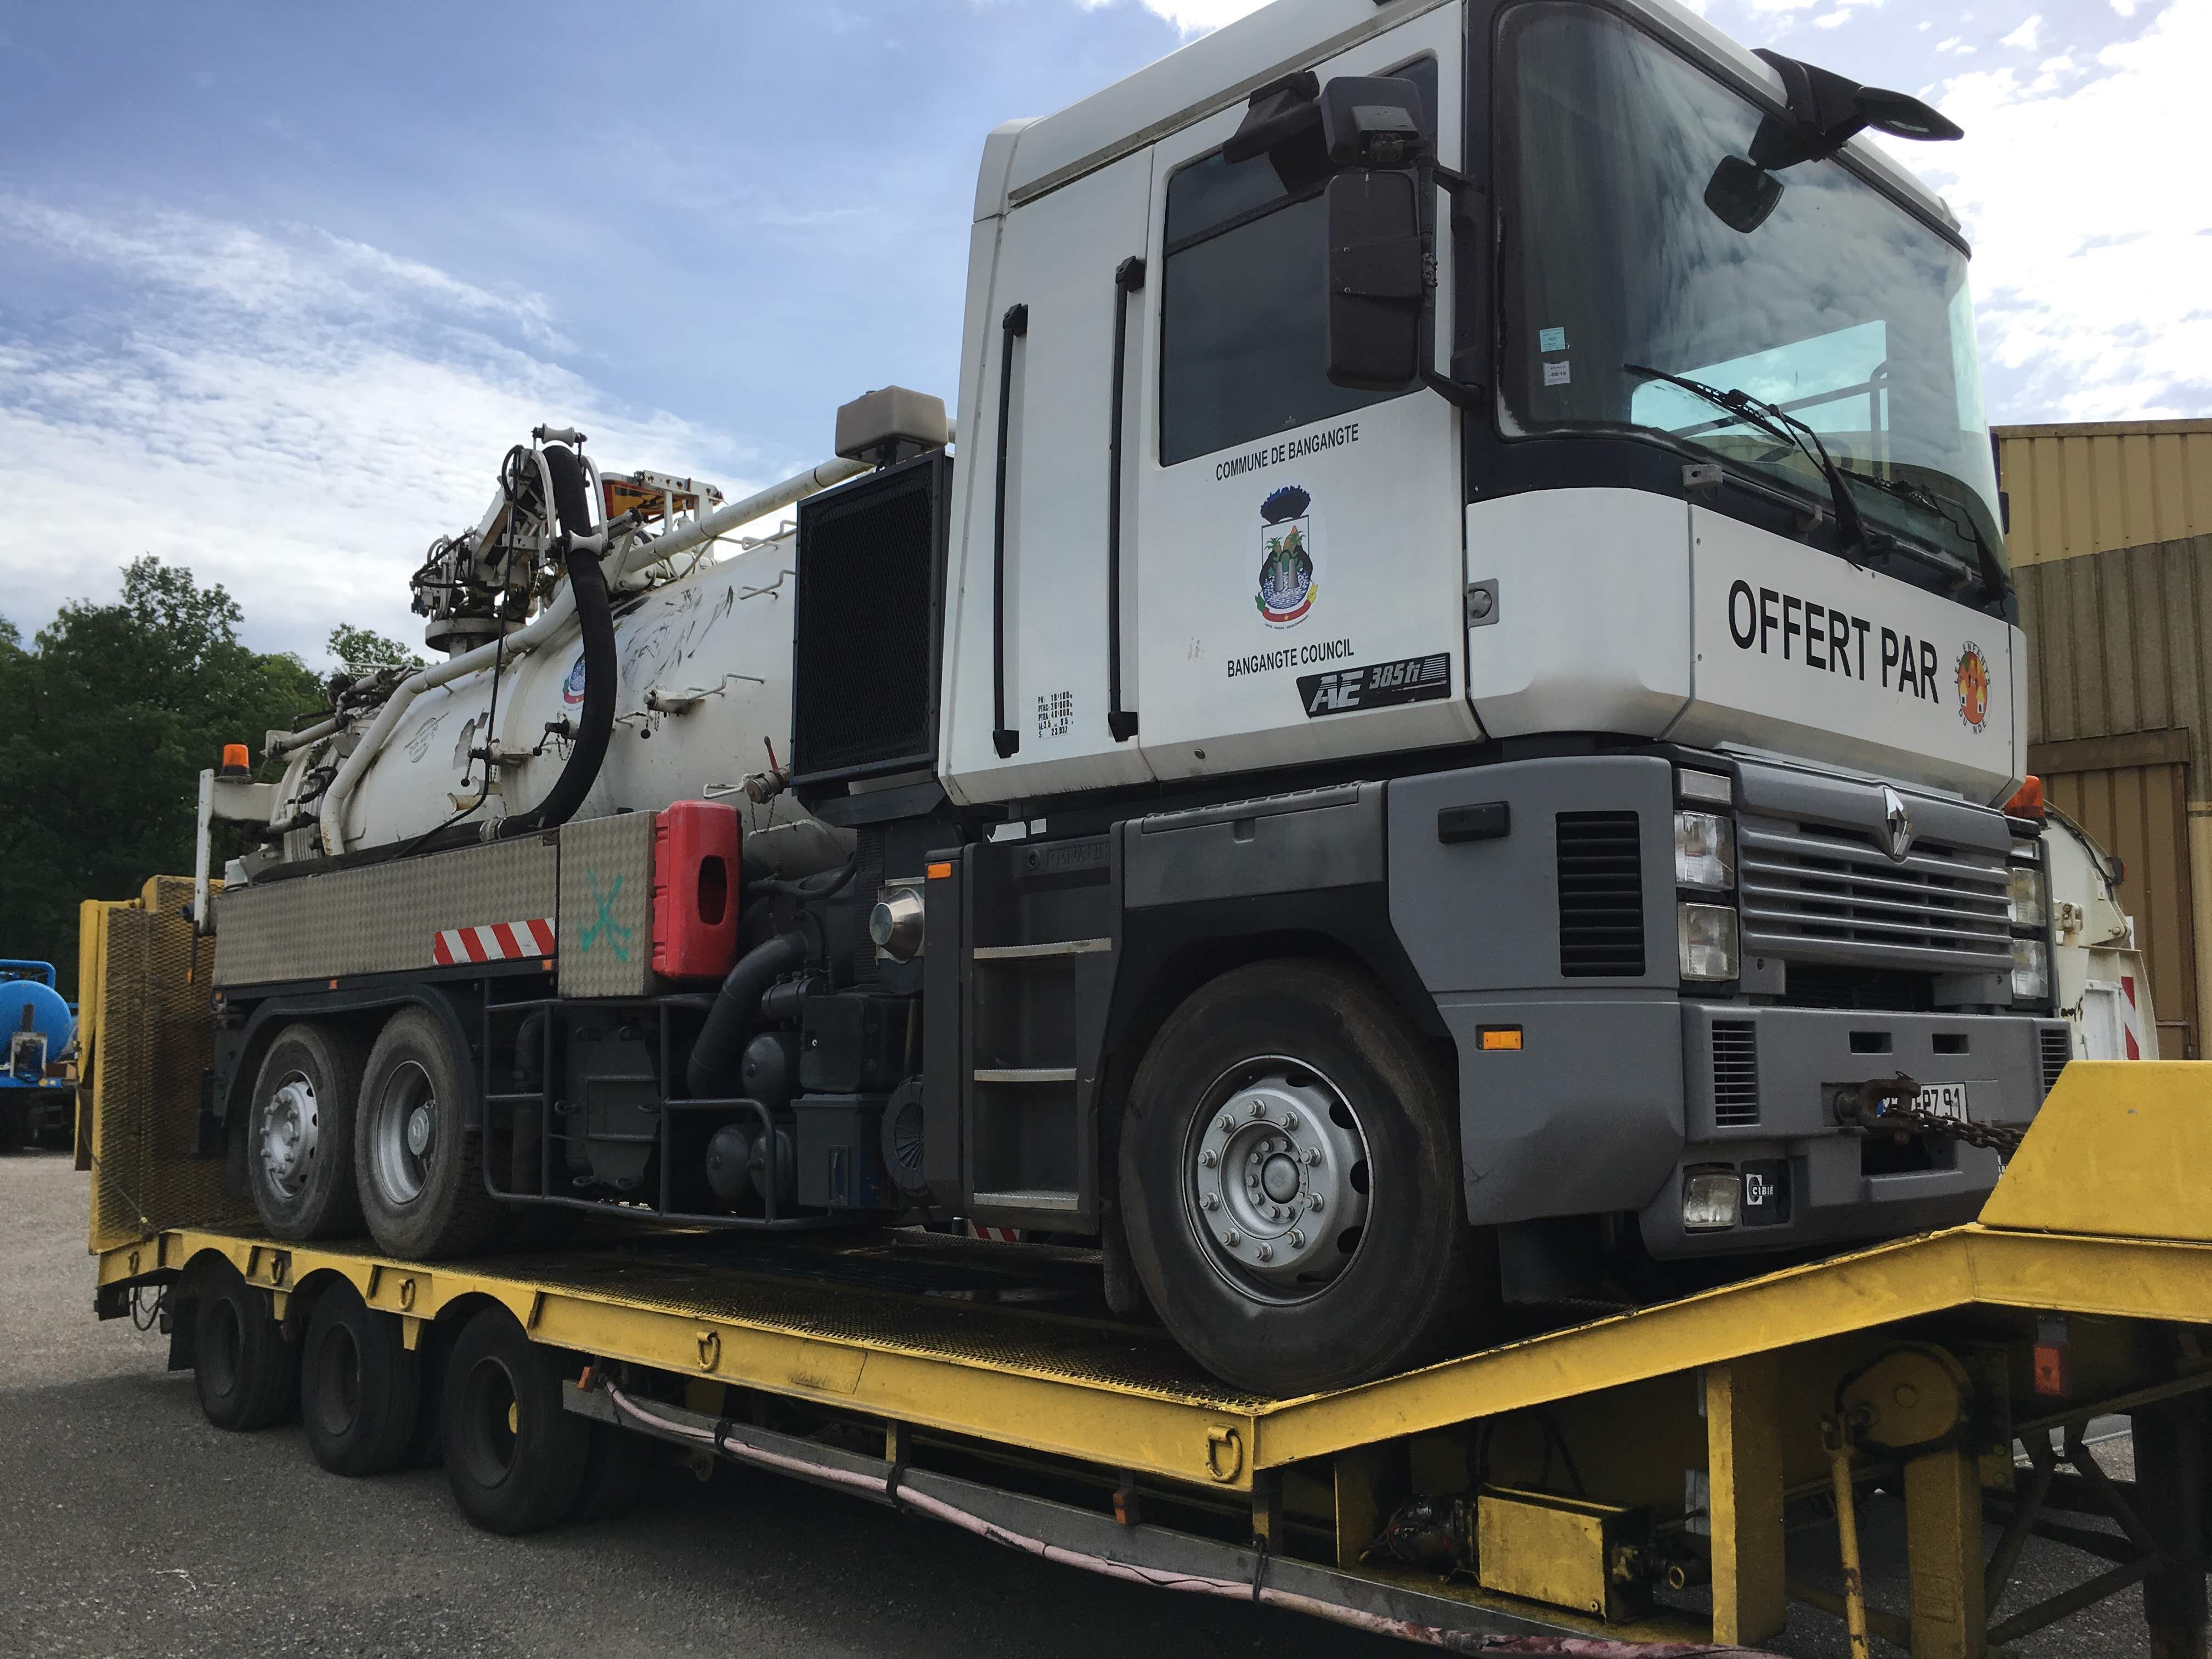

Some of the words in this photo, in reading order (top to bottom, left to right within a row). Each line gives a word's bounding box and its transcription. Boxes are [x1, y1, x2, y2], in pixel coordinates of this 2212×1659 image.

[1216, 449, 1268, 481] COMMUNE
[1271, 444, 1285, 465] DE
[1289, 423, 1359, 460] BANGANGTE
[1227, 647, 1298, 678] BANGANGTE
[1301, 638, 1355, 664] COUNCIL
[1728, 579, 1871, 681] OFFERT
[1881, 626, 1939, 704] PAR
[1962, 642, 1991, 686] ENFANTS
[1309, 670, 1364, 712] AE
[1369, 661, 1421, 690] 385ti
[1973, 719, 1987, 735] NDE
